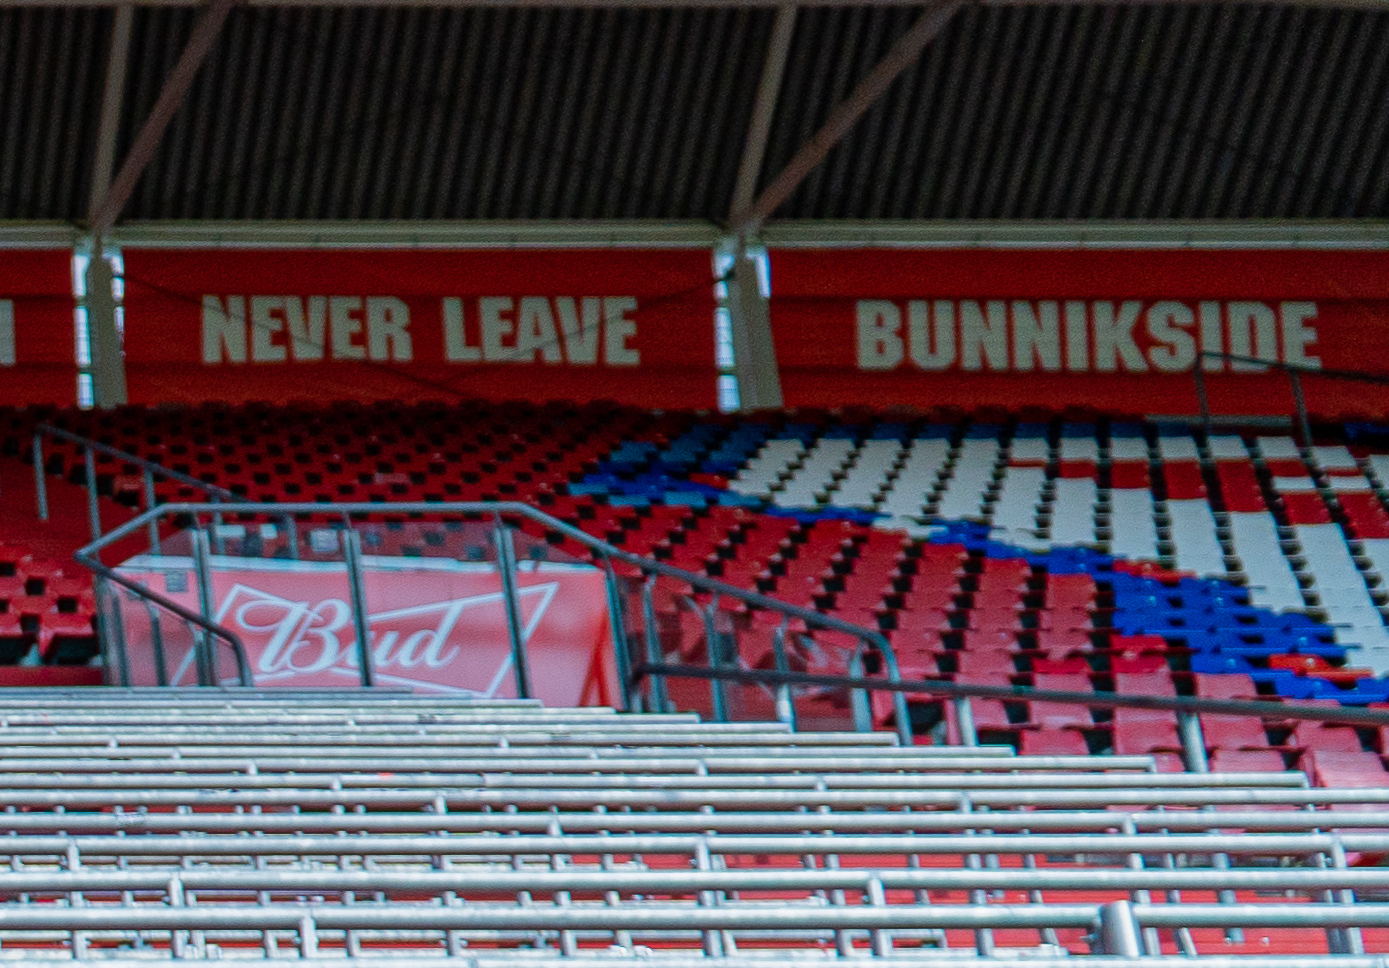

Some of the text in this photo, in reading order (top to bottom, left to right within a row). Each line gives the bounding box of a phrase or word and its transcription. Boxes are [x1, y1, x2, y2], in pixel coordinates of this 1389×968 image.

[202, 295, 640, 365] NEVER LEAVE
[856, 301, 1322, 371] BUNNIKSIDE
[234, 598, 461, 675] Bud
